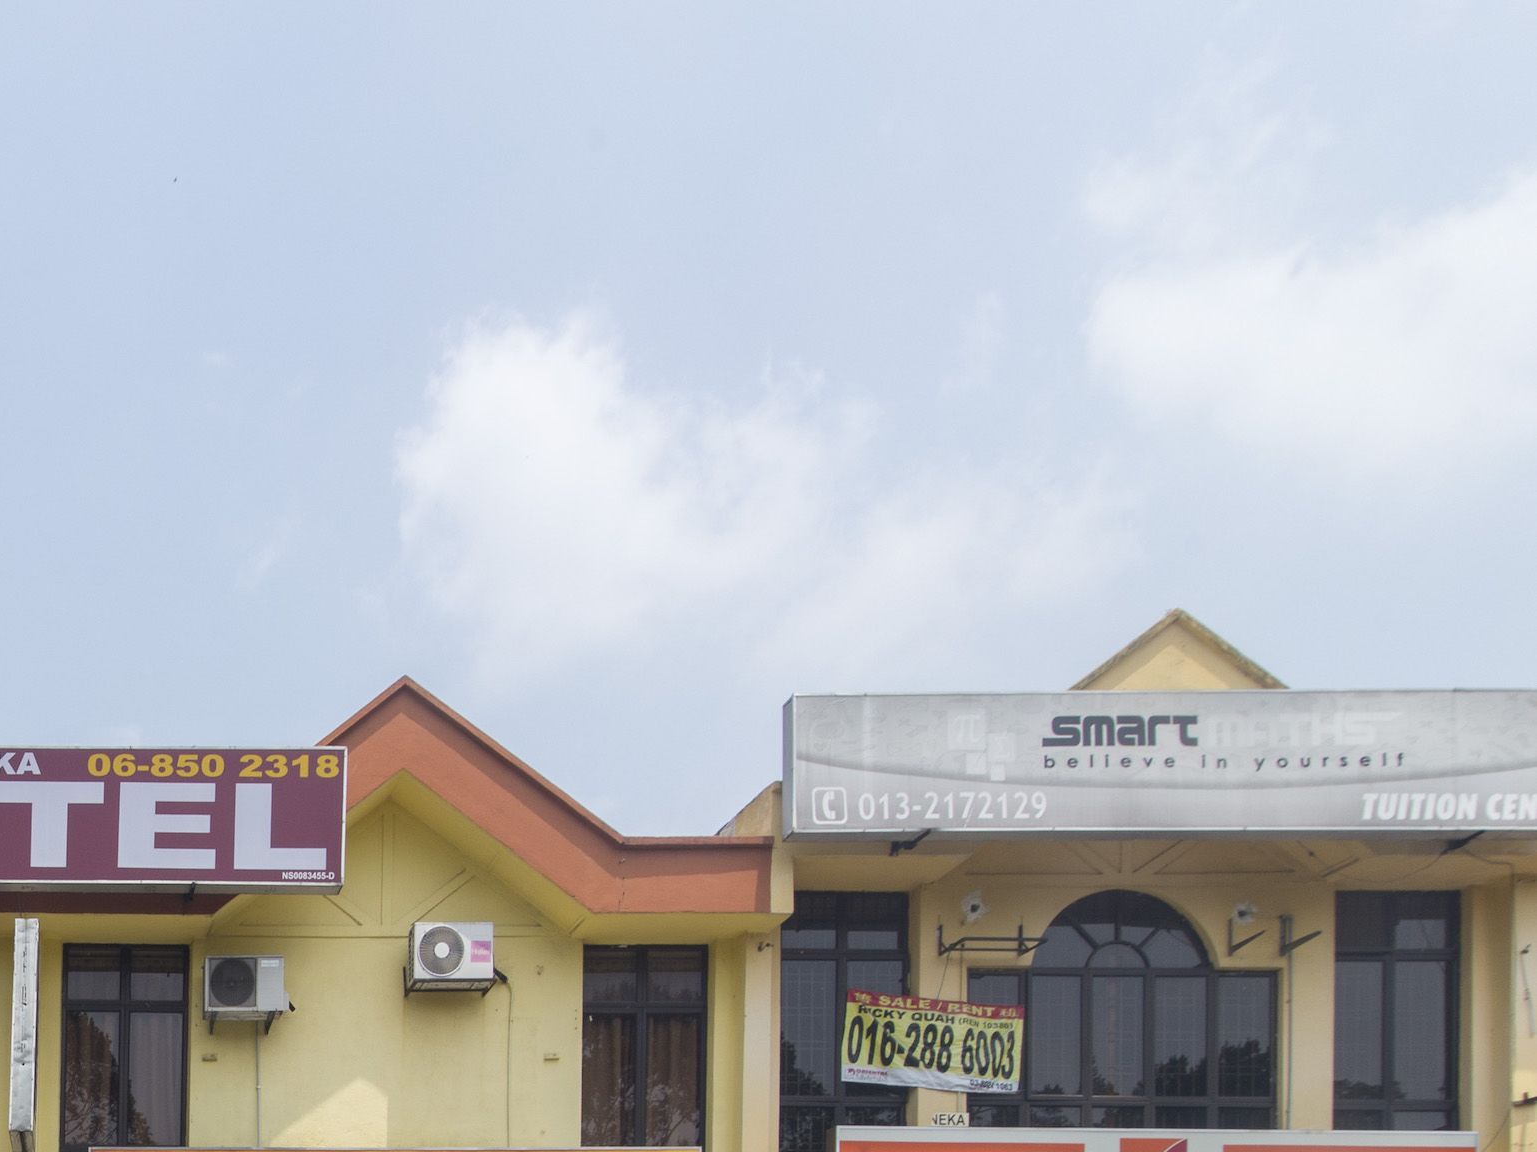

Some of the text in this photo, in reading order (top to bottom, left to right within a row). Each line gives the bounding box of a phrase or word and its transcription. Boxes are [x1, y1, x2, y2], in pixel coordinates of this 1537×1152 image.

[1042, 715, 1199, 747] smart
[87, 753, 340, 778] 06-850 2318
[1043, 753, 1405, 772] believe in yourself
[858, 791, 1047, 820] 013-2172129
[1362, 793, 1472, 820] TUITION
[282, 872, 335, 880] NS0083455-D
[879, 995, 930, 1010] SALE
[947, 1003, 995, 1017] RENT
[911, 1011, 955, 1025] QUAH
[848, 1015, 1015, 1080] 016-288 6003
